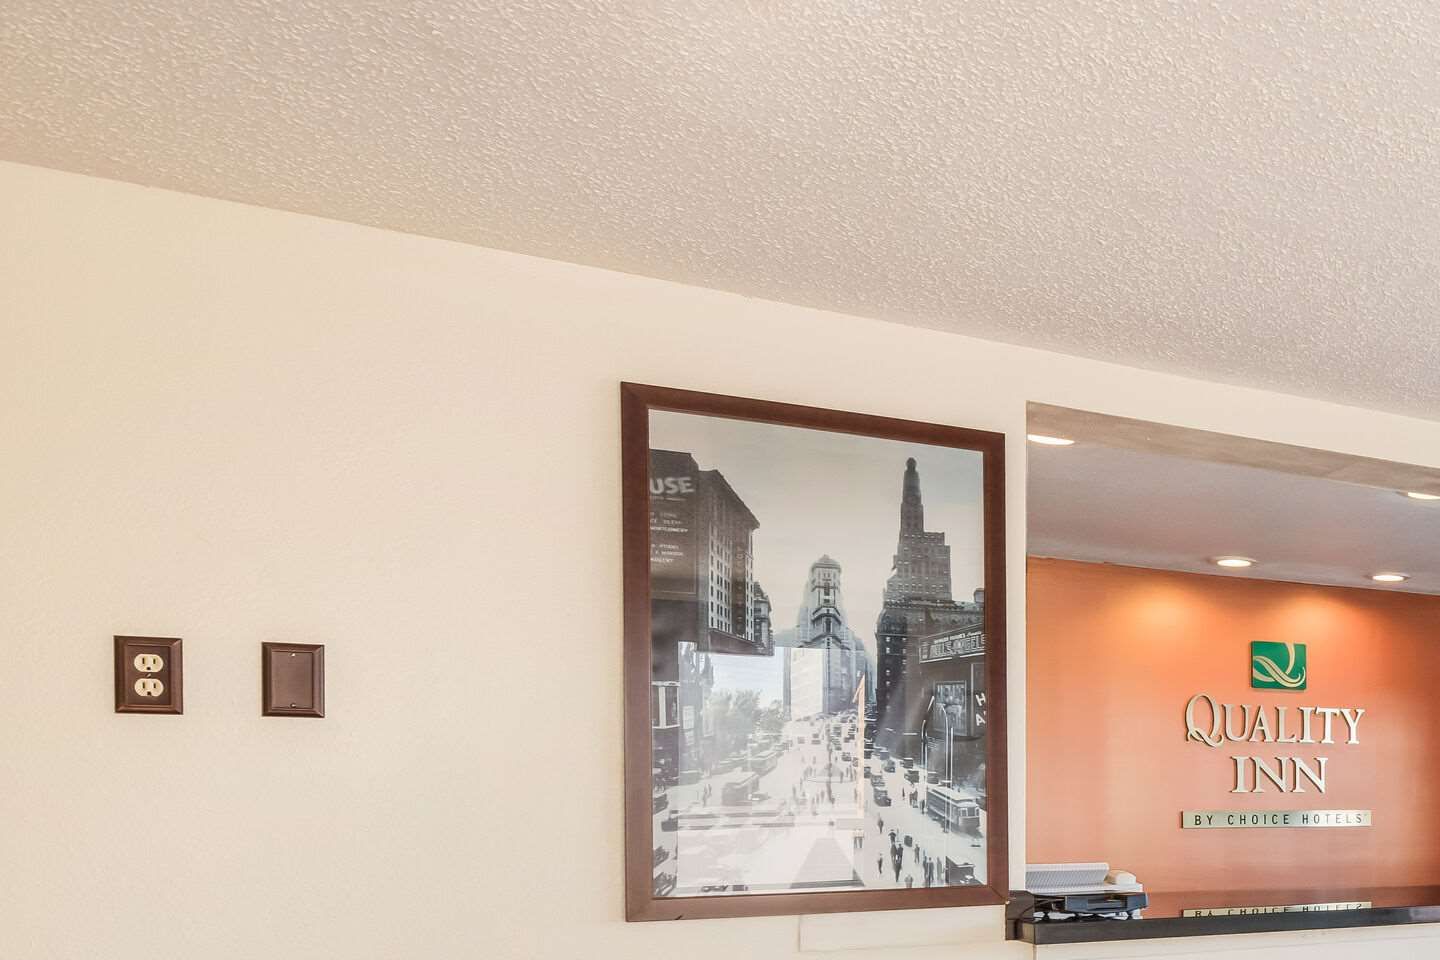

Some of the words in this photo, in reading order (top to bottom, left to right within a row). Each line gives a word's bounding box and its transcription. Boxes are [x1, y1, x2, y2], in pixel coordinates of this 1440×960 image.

[1185, 692, 1365, 748] QUALITY
[1230, 755, 1328, 794] INN
[1194, 815, 1214, 826] BY
[1227, 814, 1290, 825] CHOICE
[1302, 813, 1362, 824] HOTELS
